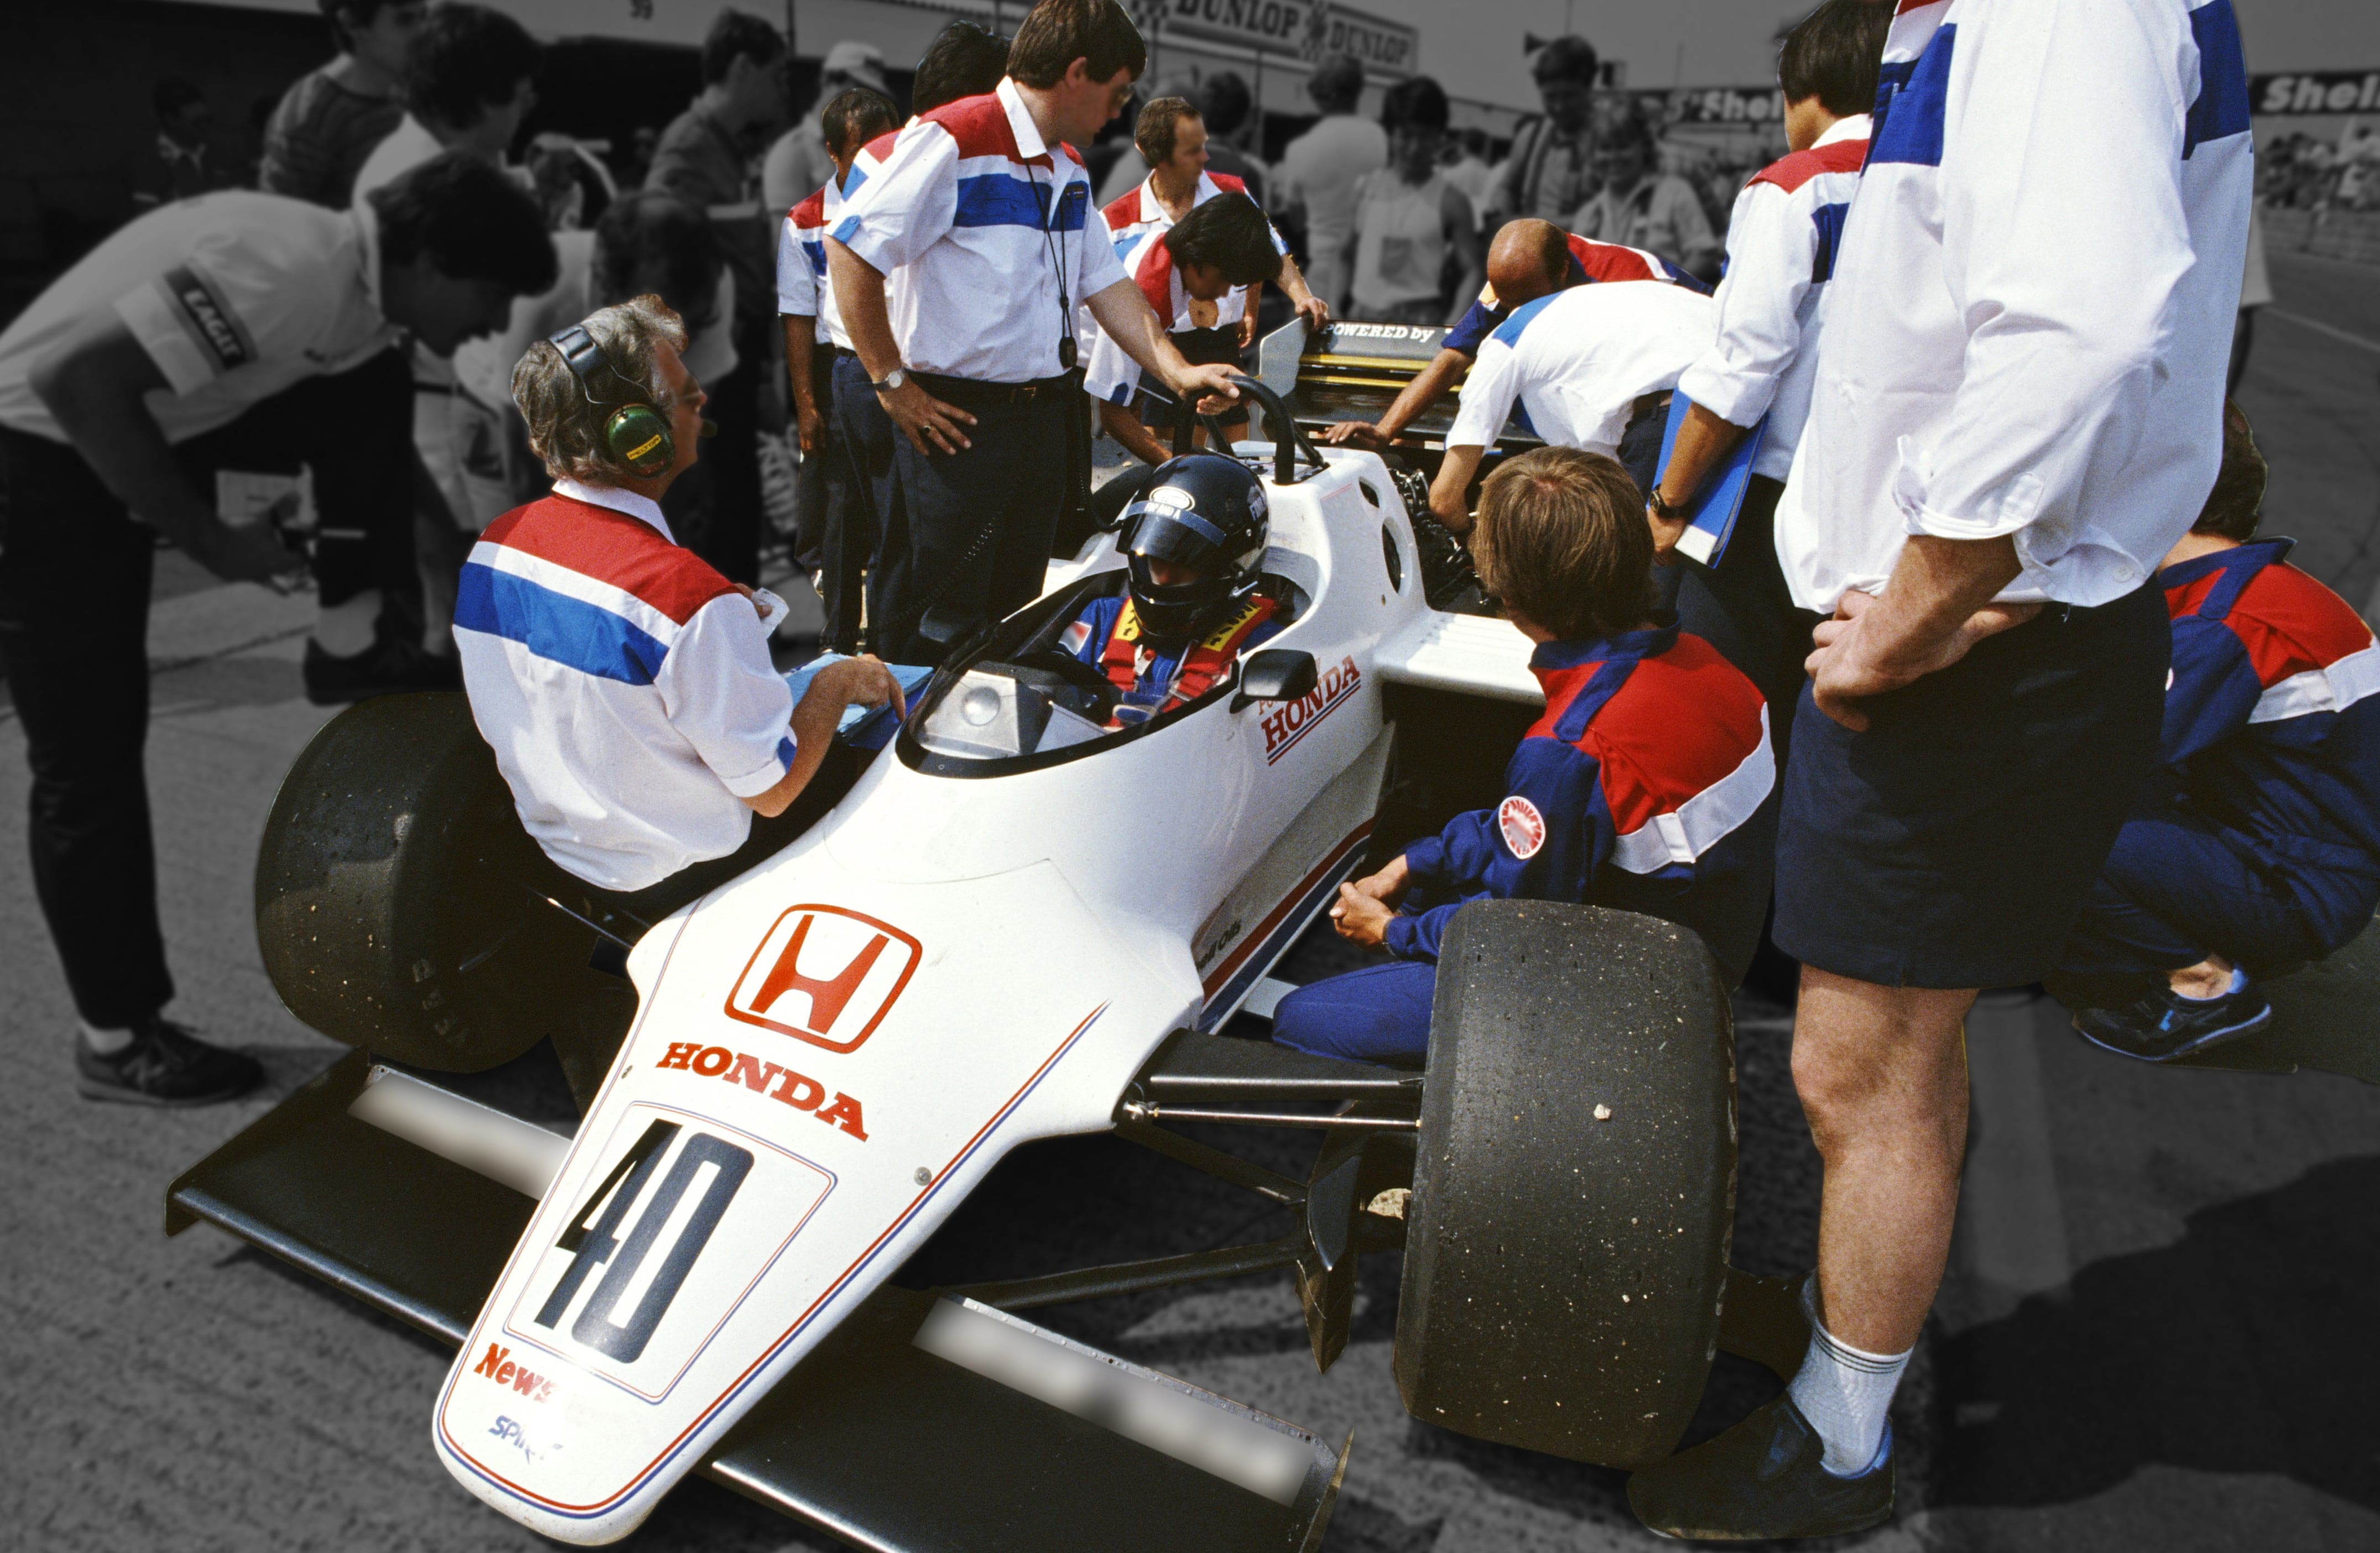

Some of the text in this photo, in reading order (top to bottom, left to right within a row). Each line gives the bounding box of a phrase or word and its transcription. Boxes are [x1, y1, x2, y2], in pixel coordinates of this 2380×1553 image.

[1329, 20, 1410, 65] DUNLOP
[1700, 90, 1783, 121] Shel
[2261, 75, 2380, 111] Shel
[1321, 323, 1408, 339] POWERED
[1410, 327, 1436, 343] by
[1260, 654, 1360, 754] HONDA
[656, 1043, 869, 1142] HONDA
[534, 1117, 755, 1364] 40
